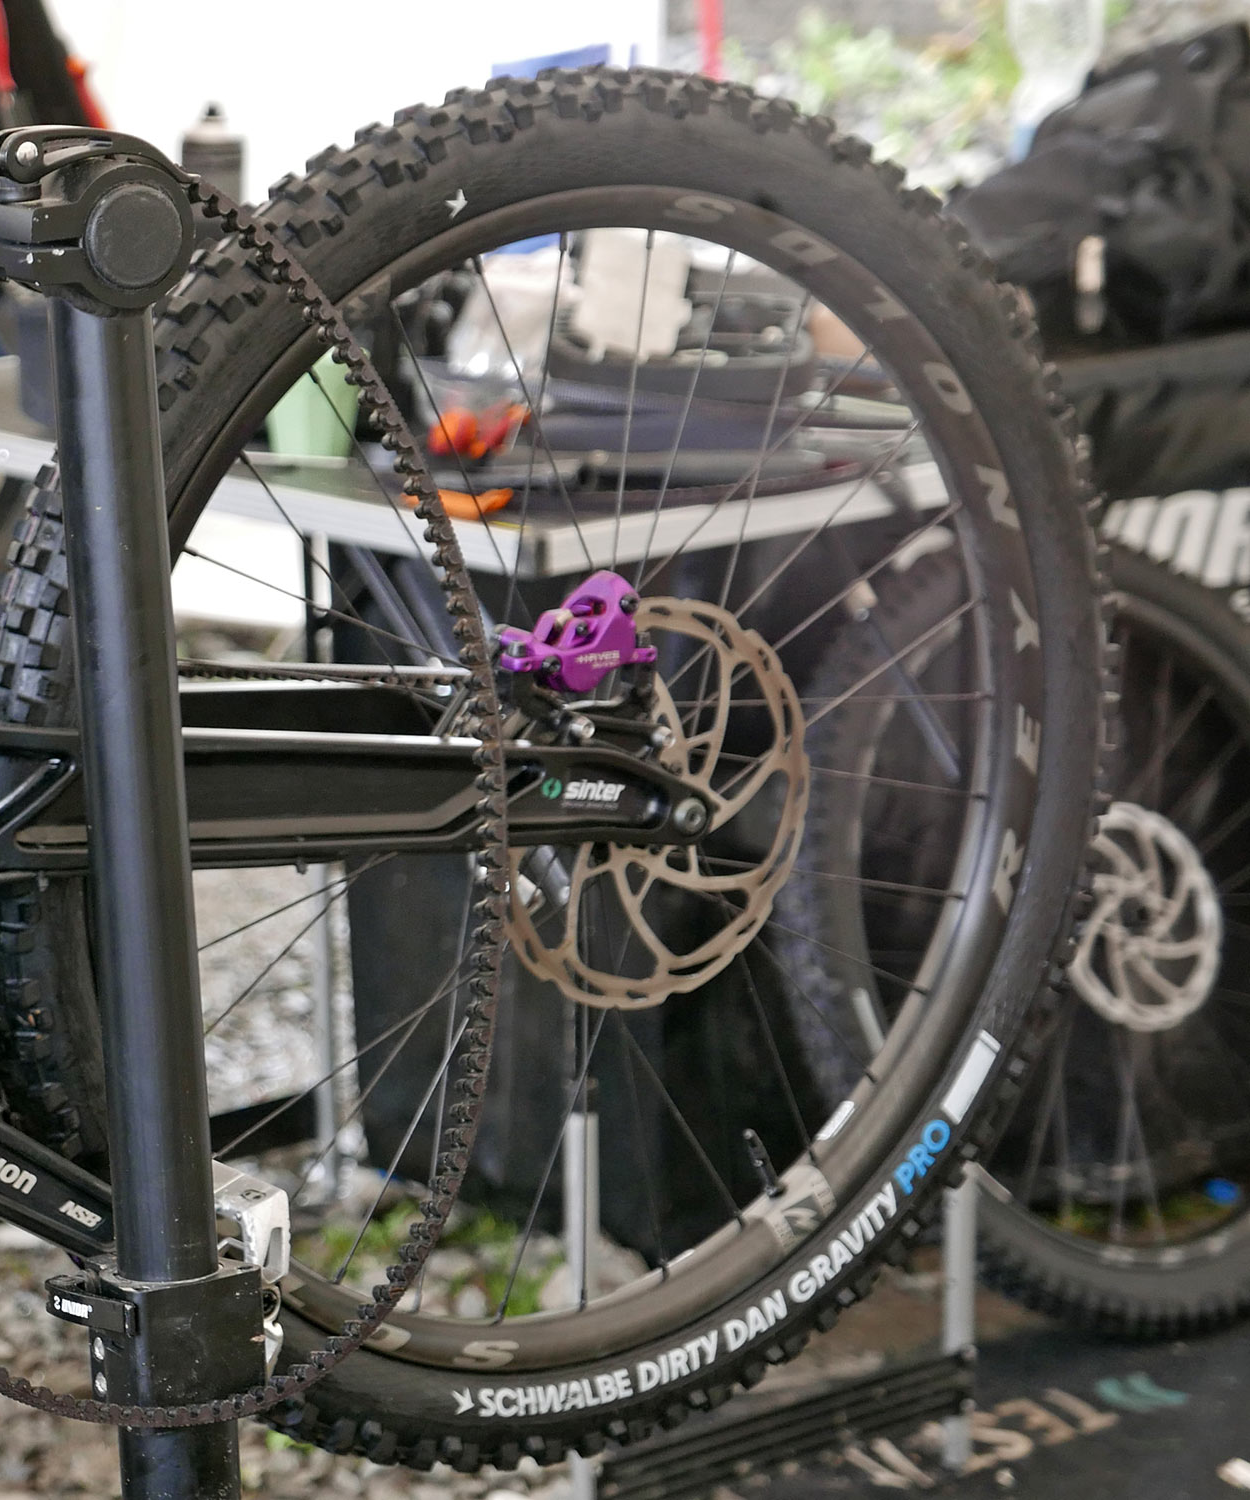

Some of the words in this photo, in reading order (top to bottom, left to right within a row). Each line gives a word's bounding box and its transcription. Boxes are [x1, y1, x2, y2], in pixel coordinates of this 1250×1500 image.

[563, 779, 626, 802] sinter
[58, 1200, 102, 1228] NSB
[478, 1369, 634, 1419] SCHWALBE
[636, 1329, 719, 1394] DIRTY
[723, 1289, 788, 1354] DAN
[788, 1181, 899, 1305] GRAVITY
[894, 1119, 951, 1196] PRO
